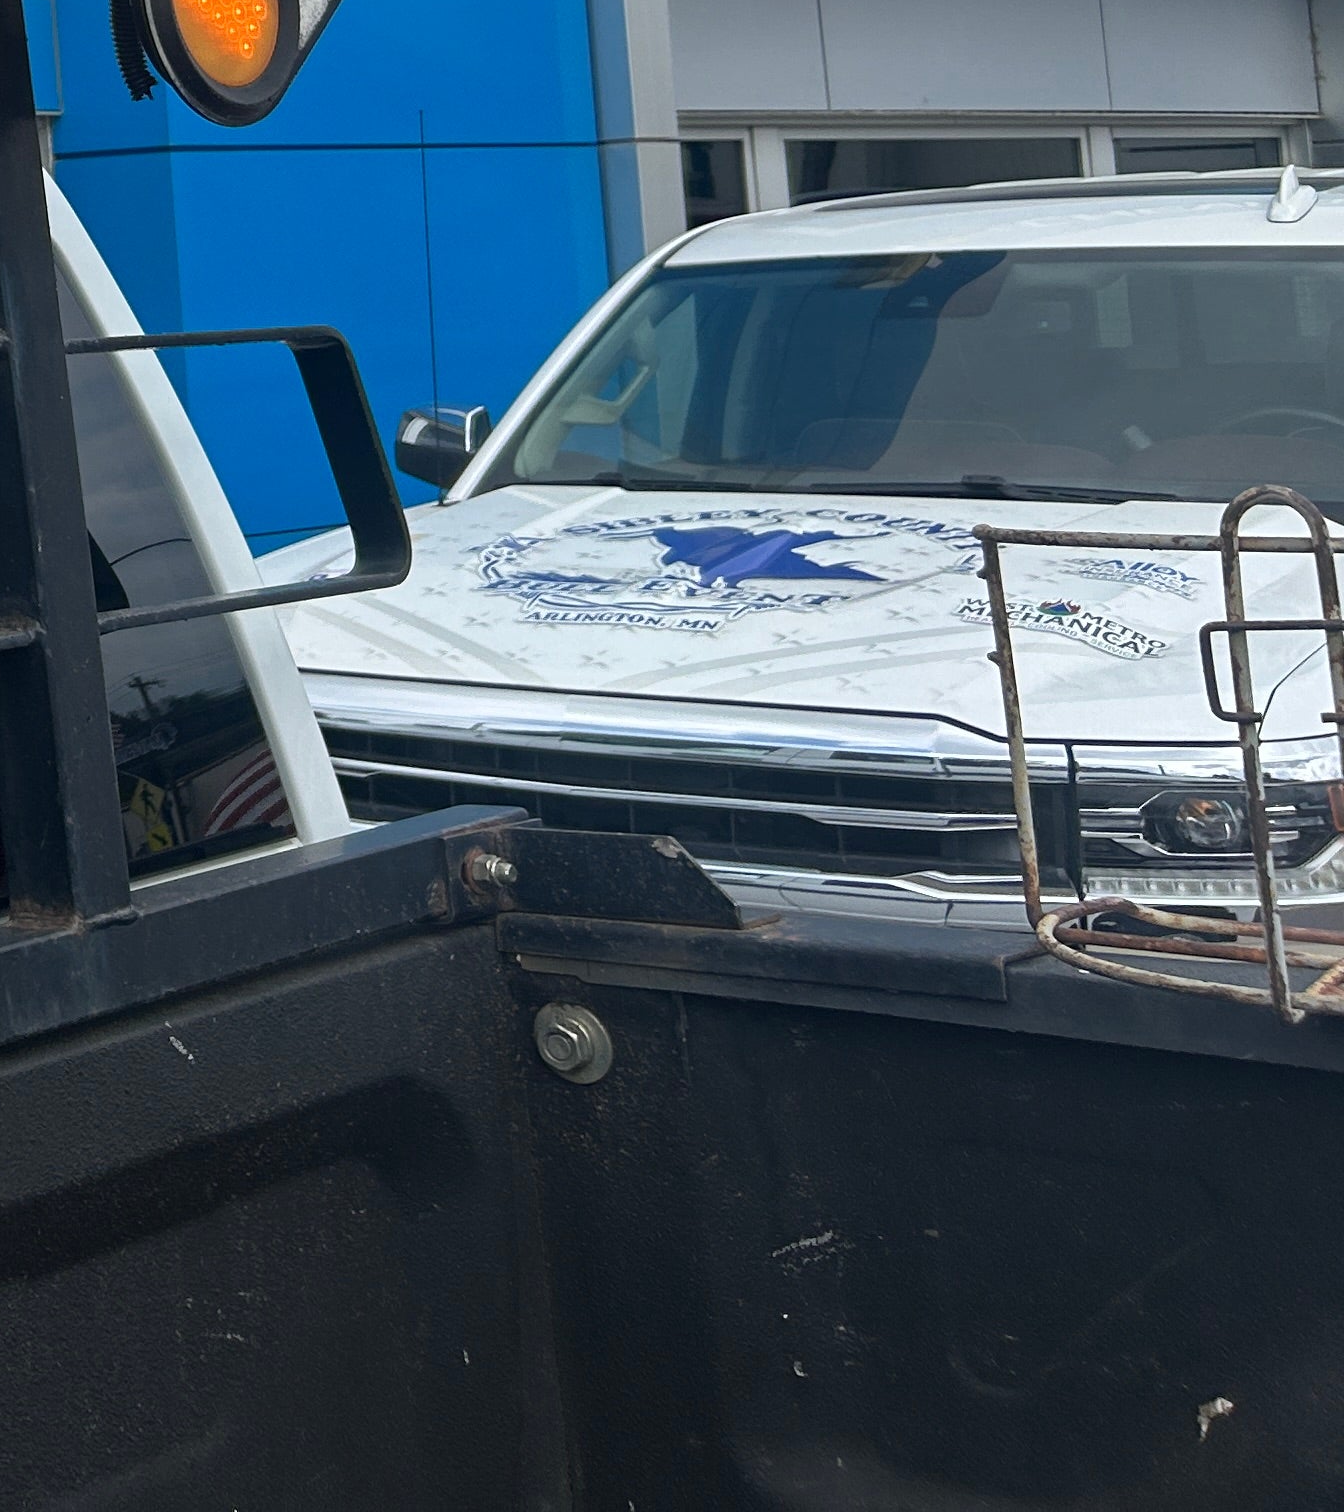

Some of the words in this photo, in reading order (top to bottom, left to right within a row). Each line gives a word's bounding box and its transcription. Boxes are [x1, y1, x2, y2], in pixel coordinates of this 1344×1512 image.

[678, 618, 721, 630] MN
[957, 603, 1161, 657] MCHANICAL
[965, 597, 1035, 612] WST
[1081, 611, 1166, 648] METRO
